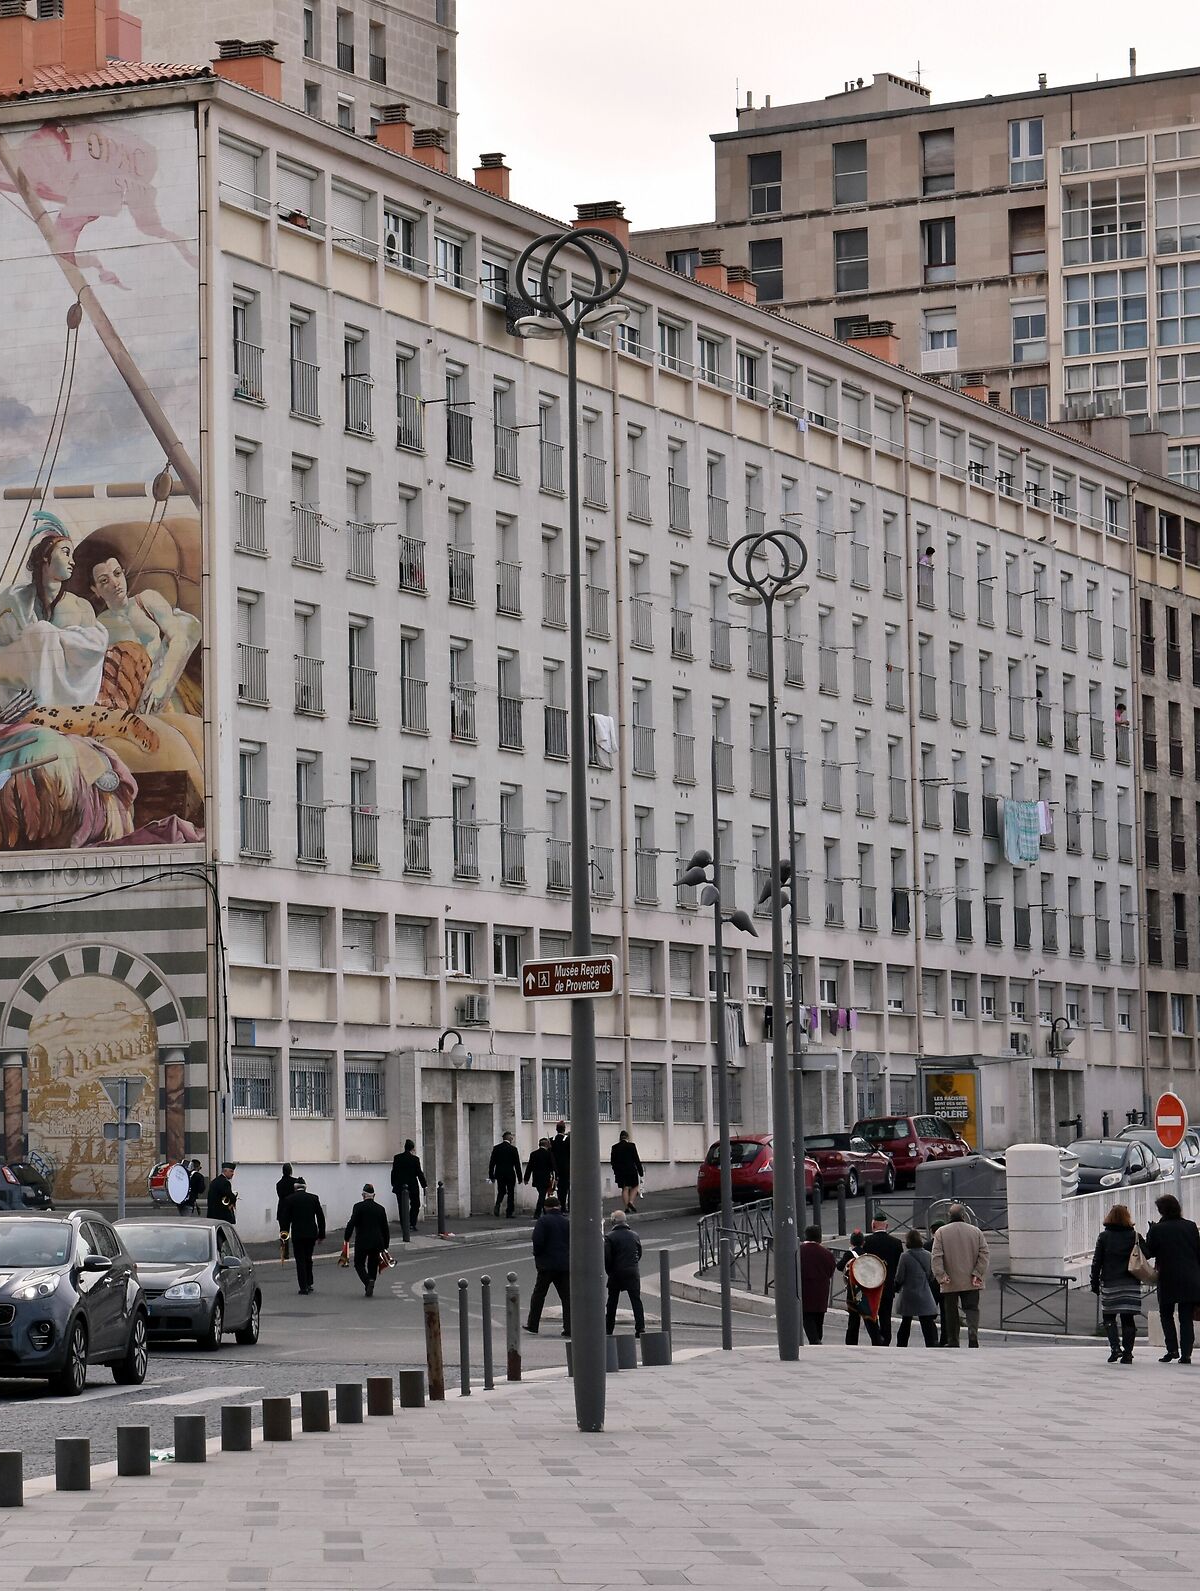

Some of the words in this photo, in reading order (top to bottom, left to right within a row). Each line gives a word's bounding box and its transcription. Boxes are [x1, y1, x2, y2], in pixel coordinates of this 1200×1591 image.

[48, 852, 186, 887] TOURETTE
[554, 964, 579, 977] Musée
[580, 962, 611, 978] Regards
[554, 980, 564, 992] de
[565, 979, 600, 992] Provence
[934, 1110, 968, 1118] COLÈRE
